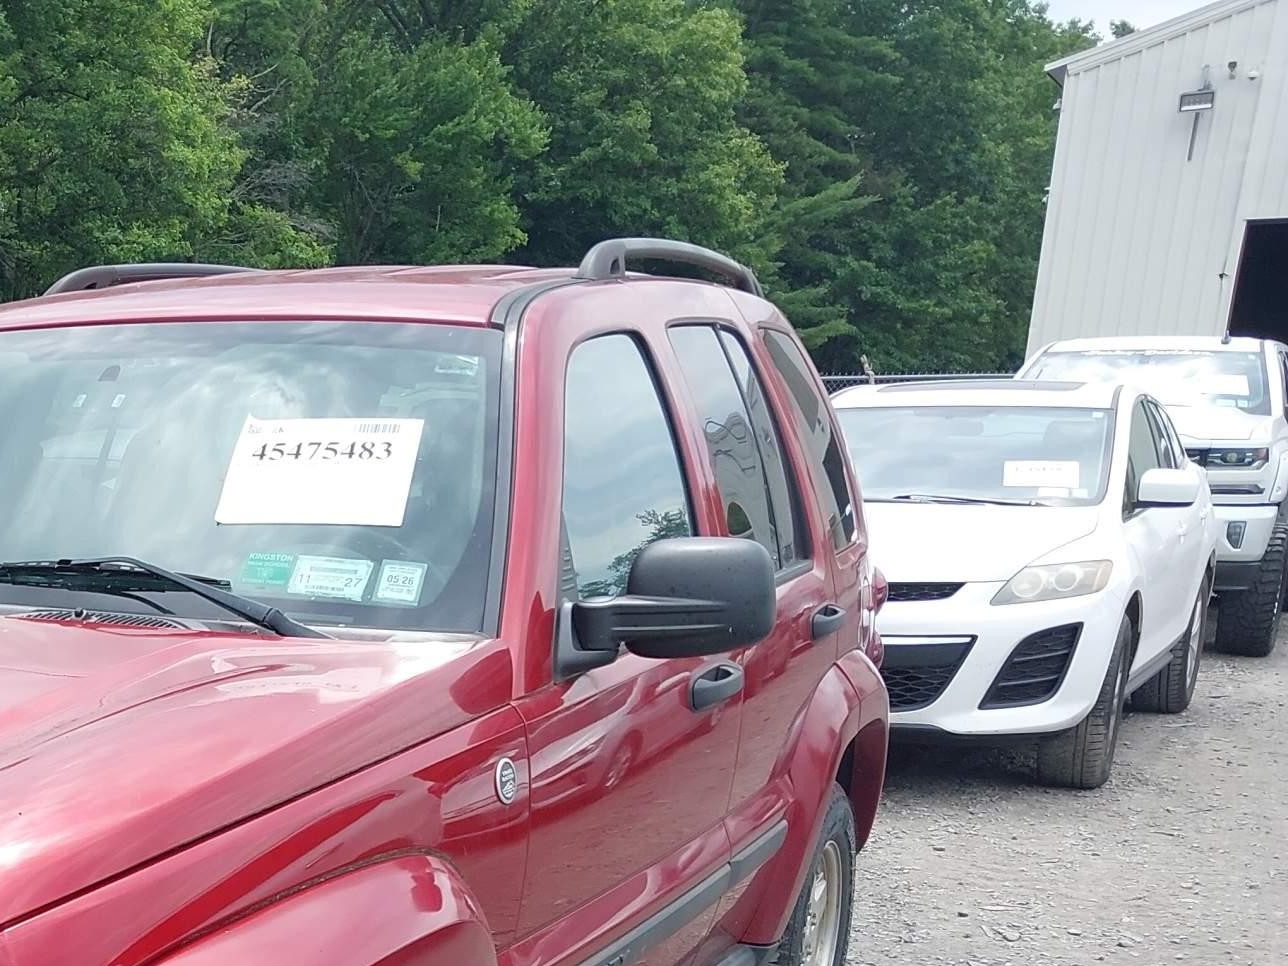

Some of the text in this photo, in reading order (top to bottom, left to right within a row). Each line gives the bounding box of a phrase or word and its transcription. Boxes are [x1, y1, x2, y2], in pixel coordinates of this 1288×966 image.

[252, 441, 393, 461] 45475483
[248, 552, 294, 562] KINGSTON
[344, 577, 364, 588] 27
